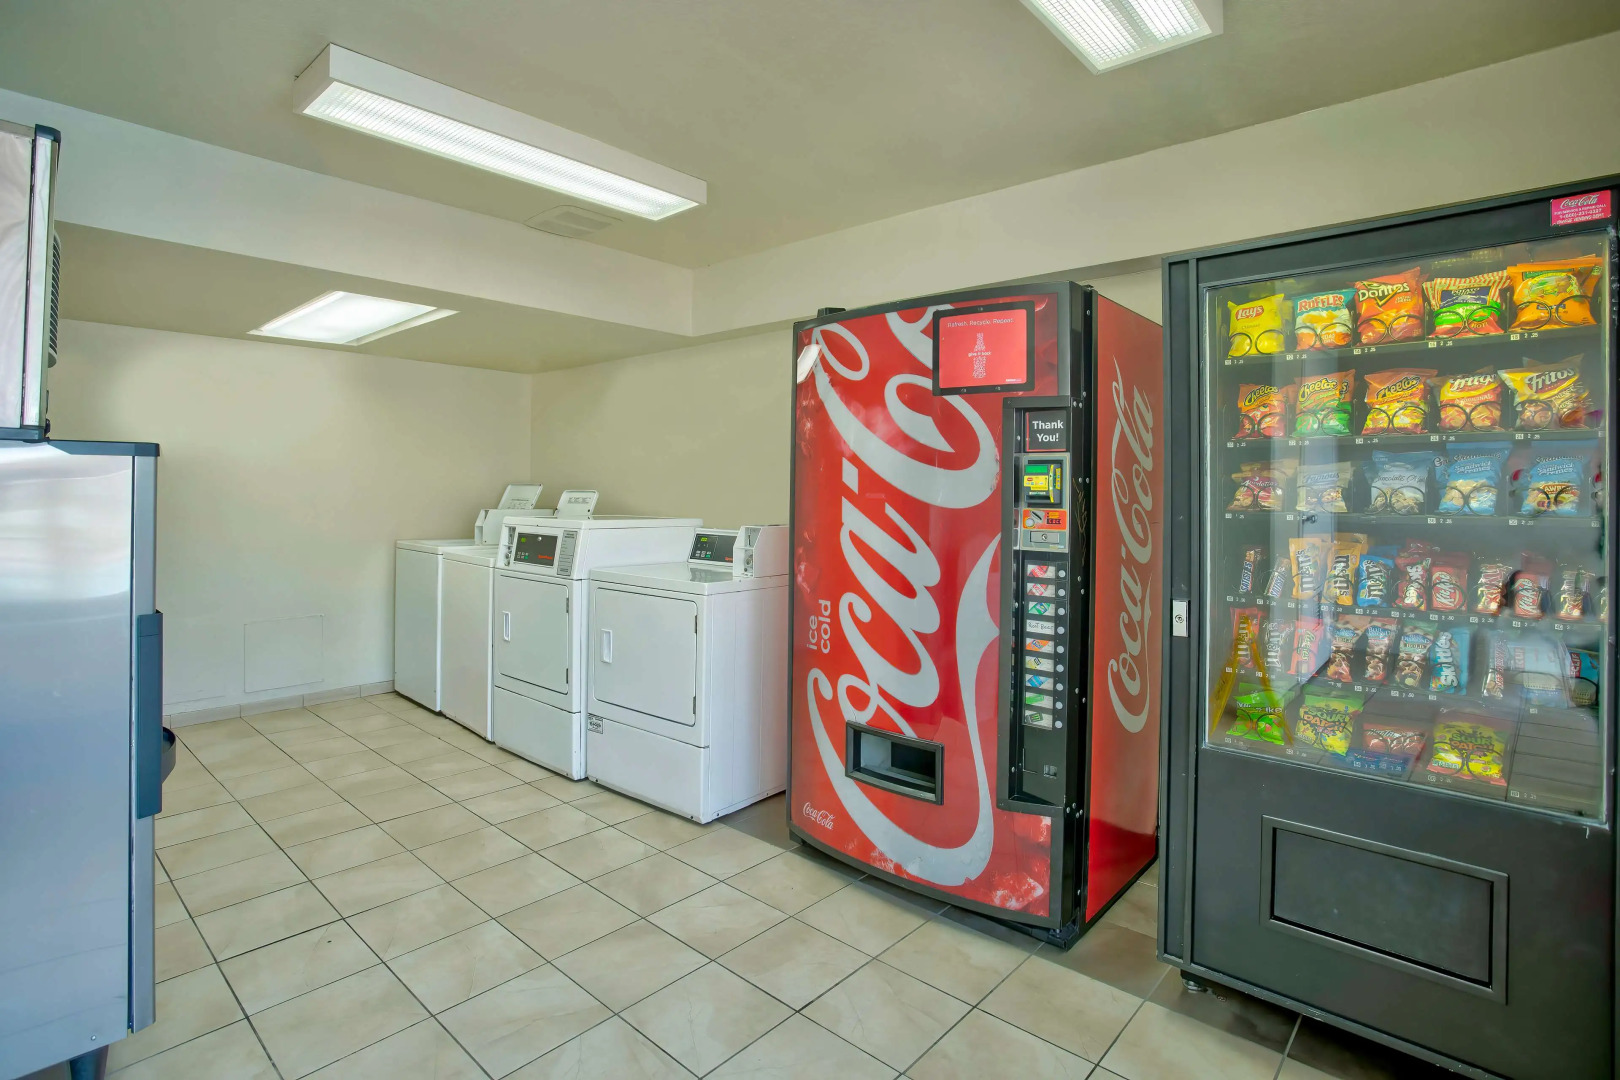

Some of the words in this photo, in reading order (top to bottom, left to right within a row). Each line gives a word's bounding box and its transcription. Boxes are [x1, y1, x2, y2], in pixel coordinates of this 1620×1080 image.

[1526, 367, 1575, 394] Fritos
[1243, 384, 1279, 407] Cheetos
[1032, 420, 1064, 429] Thank
[1036, 433, 1059, 442] You!
[806, 615, 818, 650] ice
[818, 599, 831, 654] cold
[803, 802, 835, 830] Coca-Cola
